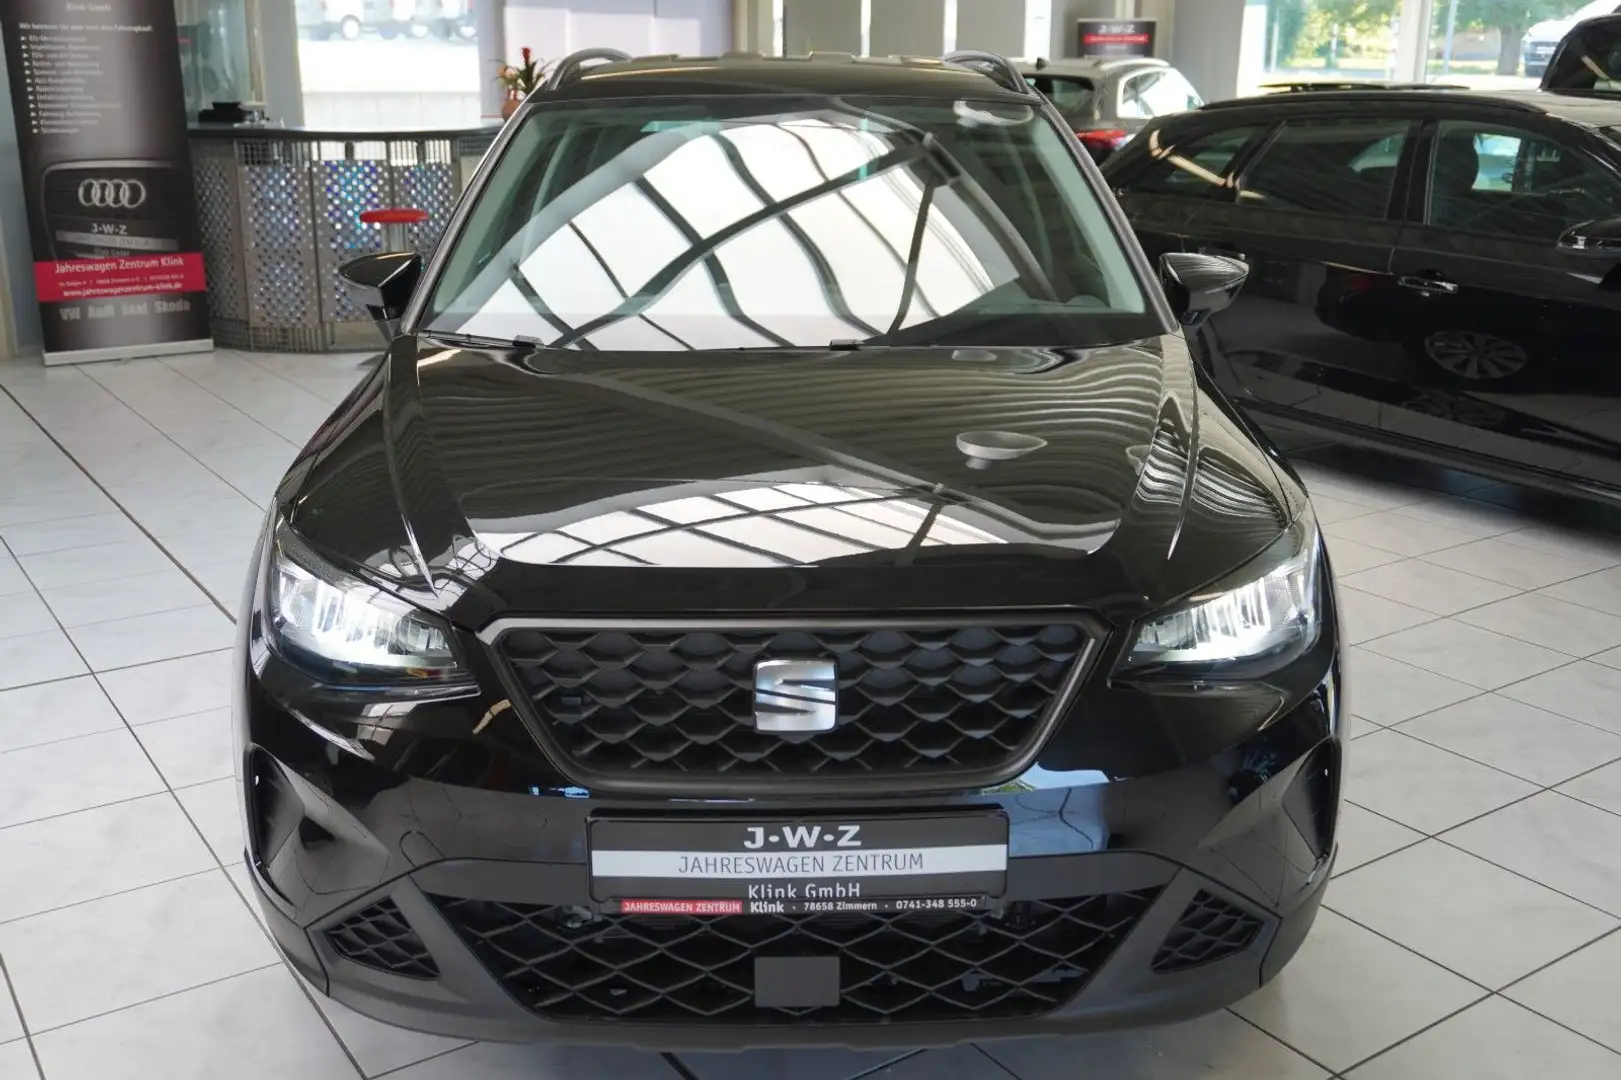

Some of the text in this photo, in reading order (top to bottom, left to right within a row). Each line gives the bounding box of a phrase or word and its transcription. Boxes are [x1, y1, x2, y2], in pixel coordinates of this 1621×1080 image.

[55, 256, 184, 275] Jahreswagen Zentrum Klink
[678, 852, 923, 874] JAHRESWAGEN ZENTRUM
[748, 882, 860, 899] Klink GmbH
[623, 898, 977, 913] JAHRESWAGEN ZENTRUM Klink 78658 Zimmern 0741-348 555-0
